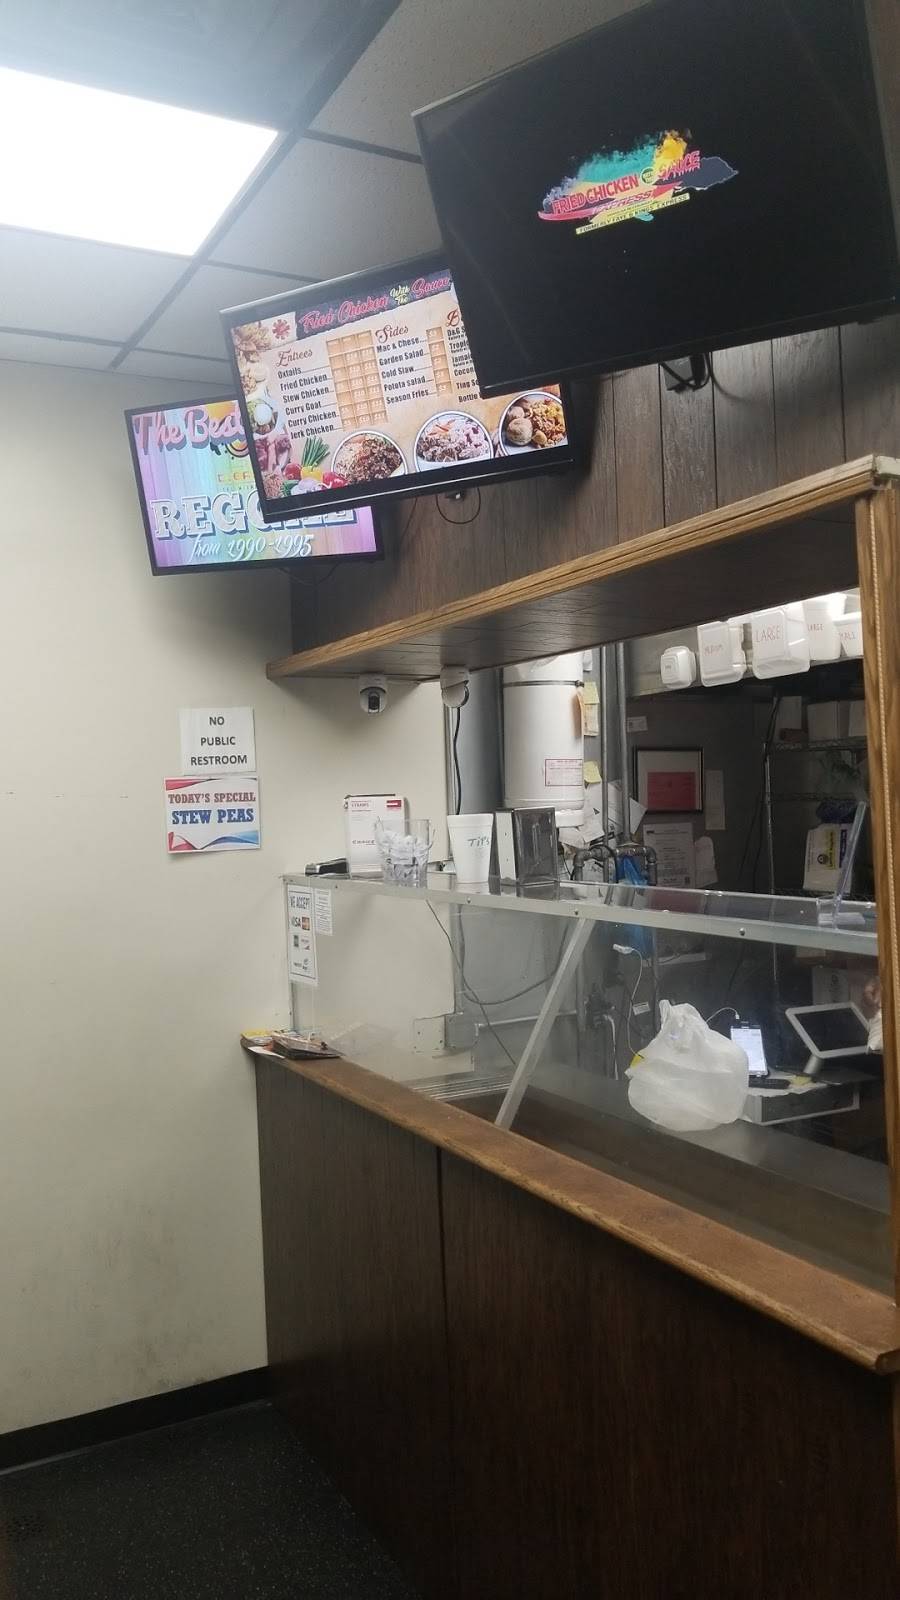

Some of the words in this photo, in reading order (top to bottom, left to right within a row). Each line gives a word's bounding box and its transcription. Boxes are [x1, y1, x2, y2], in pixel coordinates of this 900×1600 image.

[551, 192, 586, 214] FRIED
[586, 174, 639, 203] CHICKEN
[299, 310, 335, 333] Fried
[338, 294, 390, 322] Chicken
[375, 324, 409, 343] Sides
[377, 343, 390, 353] Mac
[276, 348, 313, 367] Entrees
[379, 355, 404, 366] Garden
[405, 349, 424, 360] Salad
[278, 367, 302, 379] Oxtails
[381, 368, 397, 379] Cold
[398, 364, 415, 374] Slaw
[280, 381, 298, 392] Fried
[299, 373, 327, 387] Chicken
[283, 393, 300, 404] Stew
[300, 386, 329, 399] Chicken
[386, 393, 412, 405] Season
[412, 389, 429, 400] Fries
[458, 393, 478, 403] Bottle
[285, 404, 304, 417] Curry
[306, 400, 322, 411] Goat
[288, 416, 307, 429] Curry
[307, 410, 336, 423] Chicken
[132, 410, 184, 454] The
[290, 430, 304, 440] Jerk
[306, 423, 334, 437] Chicken
[189, 534, 220, 562] from
[754, 624, 781, 642] LARGE
[209, 716, 225, 726] NO
[200, 736, 236, 746] PUBLIC
[190, 755, 248, 766] RESTROOM
[168, 793, 211, 804] TODAY'S
[214, 792, 256, 803] SPECIAL
[172, 809, 212, 825] STEW
[217, 808, 254, 824] PEAS
